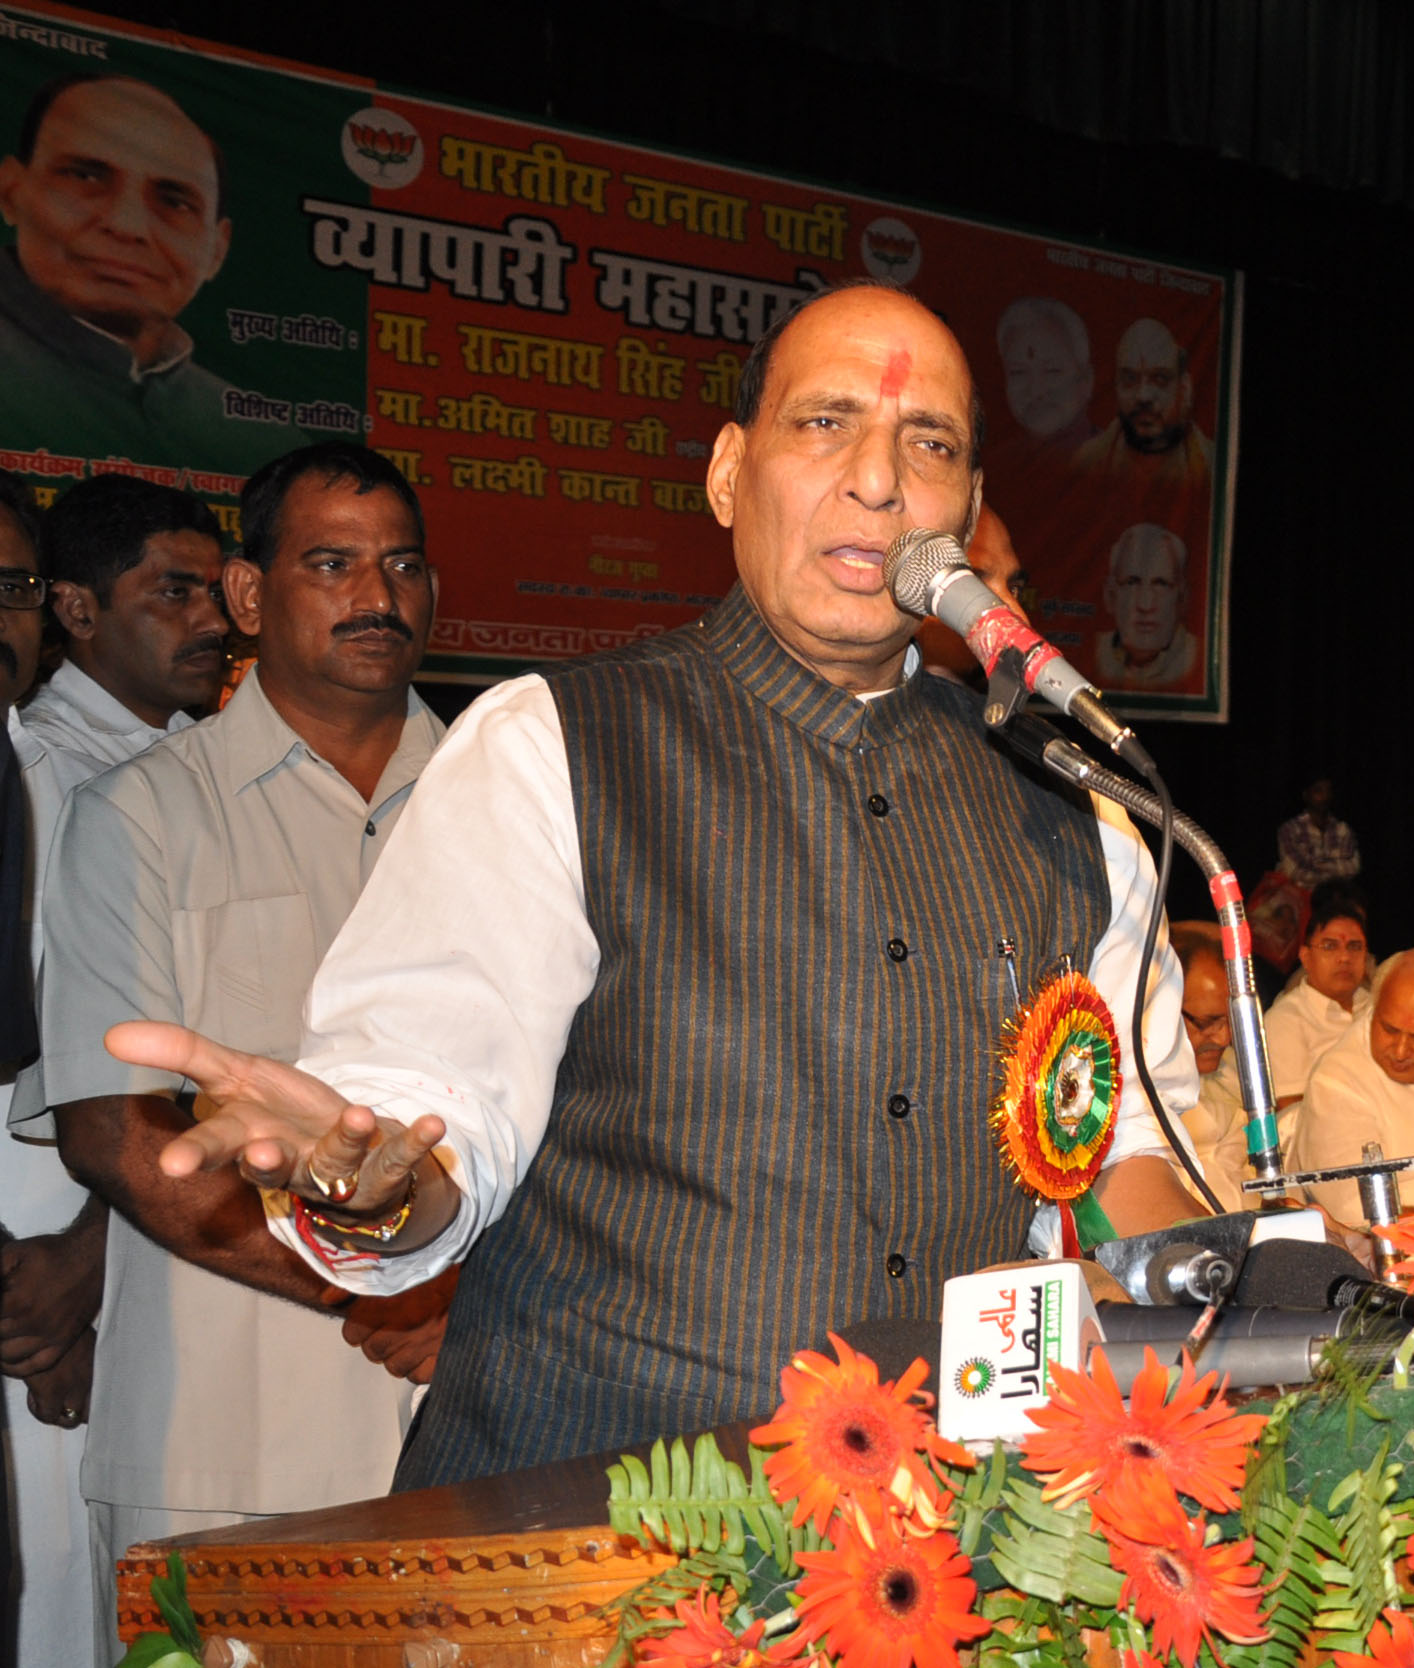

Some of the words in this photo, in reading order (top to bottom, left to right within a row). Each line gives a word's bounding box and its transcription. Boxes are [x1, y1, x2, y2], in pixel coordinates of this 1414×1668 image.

[440, 135, 611, 214] भारतीय
[624, 174, 749, 242] जनता
[762, 200, 848, 260] पार्टी
[302, 195, 576, 314] व्यापारी
[226, 308, 278, 344] मुख्य
[374, 310, 440, 368] मा.
[458, 322, 604, 389] राजनाथ
[616, 337, 686, 404] सिंह
[547, 410, 614, 450] शाह
[623, 416, 671, 457] जी
[448, 454, 550, 498] लक्ष्मी
[558, 466, 642, 508] कान्त
[1046, 1281, 1060, 1339] SAHARA
